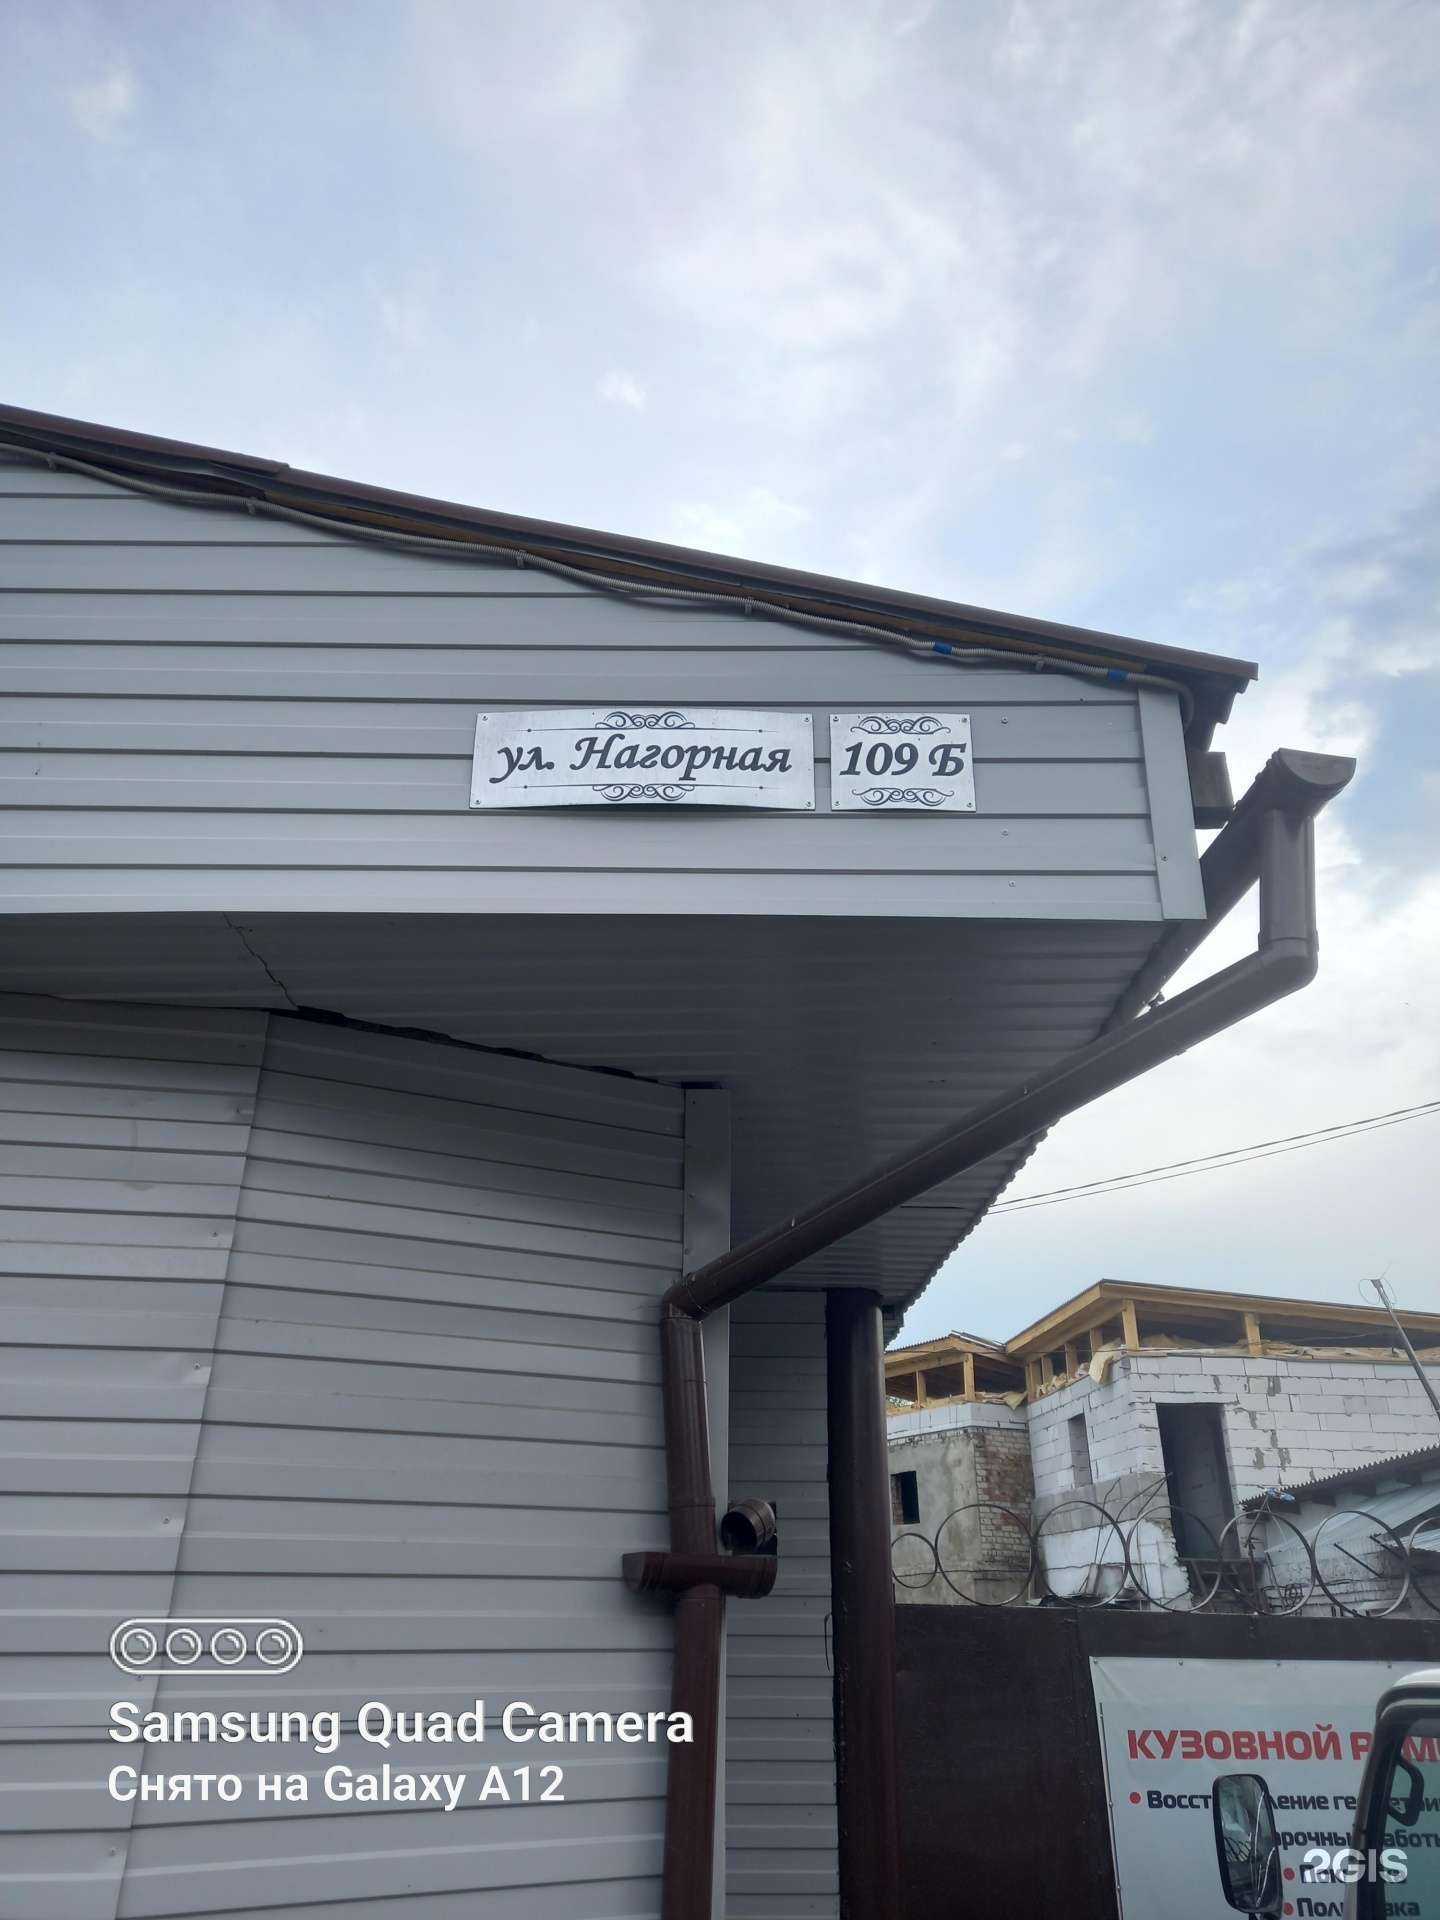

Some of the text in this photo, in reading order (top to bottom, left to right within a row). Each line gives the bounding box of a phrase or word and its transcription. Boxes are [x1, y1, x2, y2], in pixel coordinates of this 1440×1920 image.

[489, 734, 792, 784] ул. Нагорная
[840, 742, 967, 777] 109 Б
[1127, 1723, 1342, 1761] КУЗОВНОЙ
